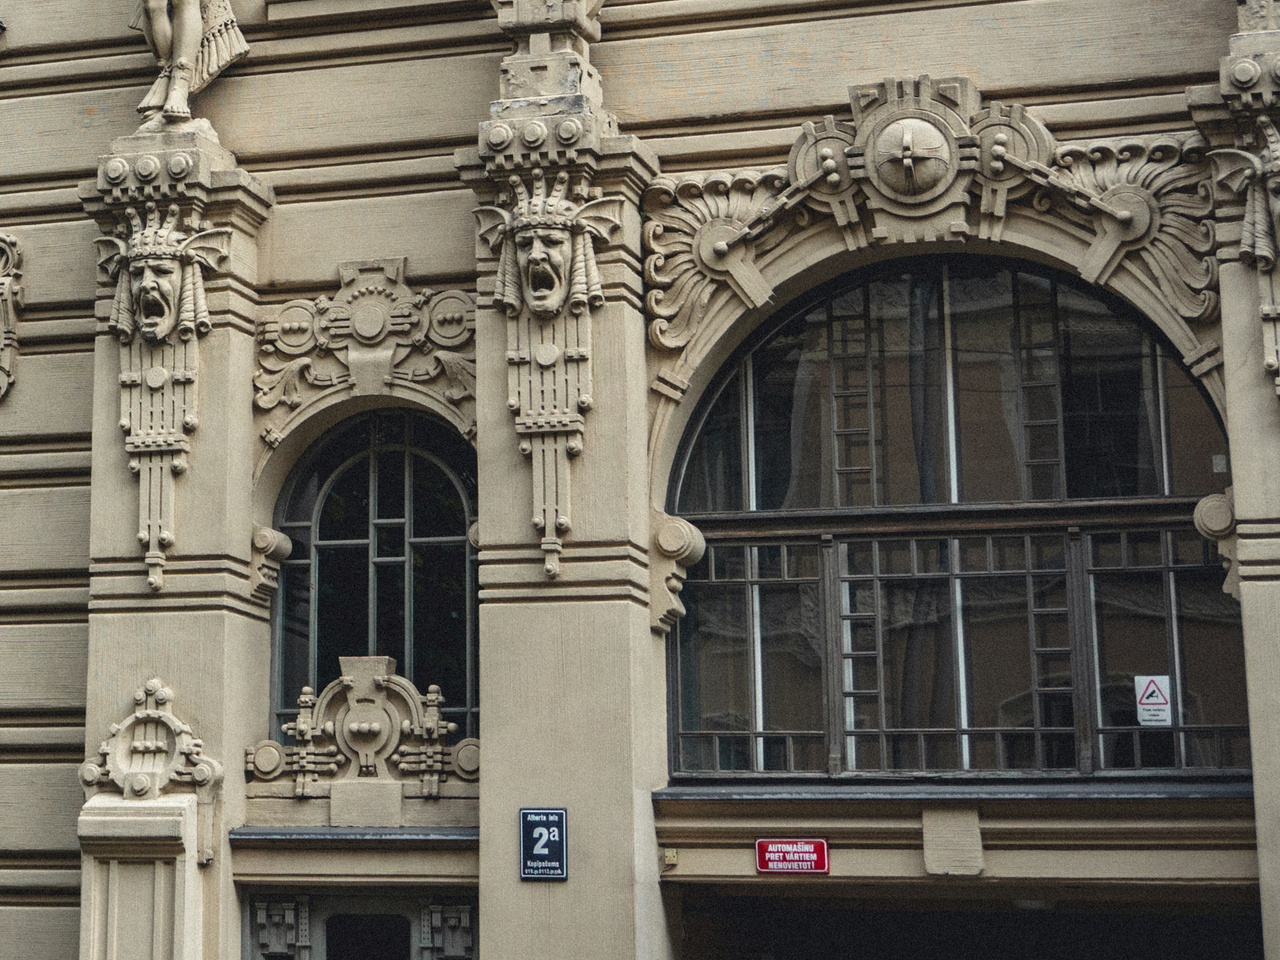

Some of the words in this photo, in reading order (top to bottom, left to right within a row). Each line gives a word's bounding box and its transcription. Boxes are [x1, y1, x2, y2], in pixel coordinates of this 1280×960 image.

[532, 826, 559, 855] 2a
[768, 842, 814, 852] AUTOMAŠĪNU
[785, 852, 817, 861] VĀRTIEM
